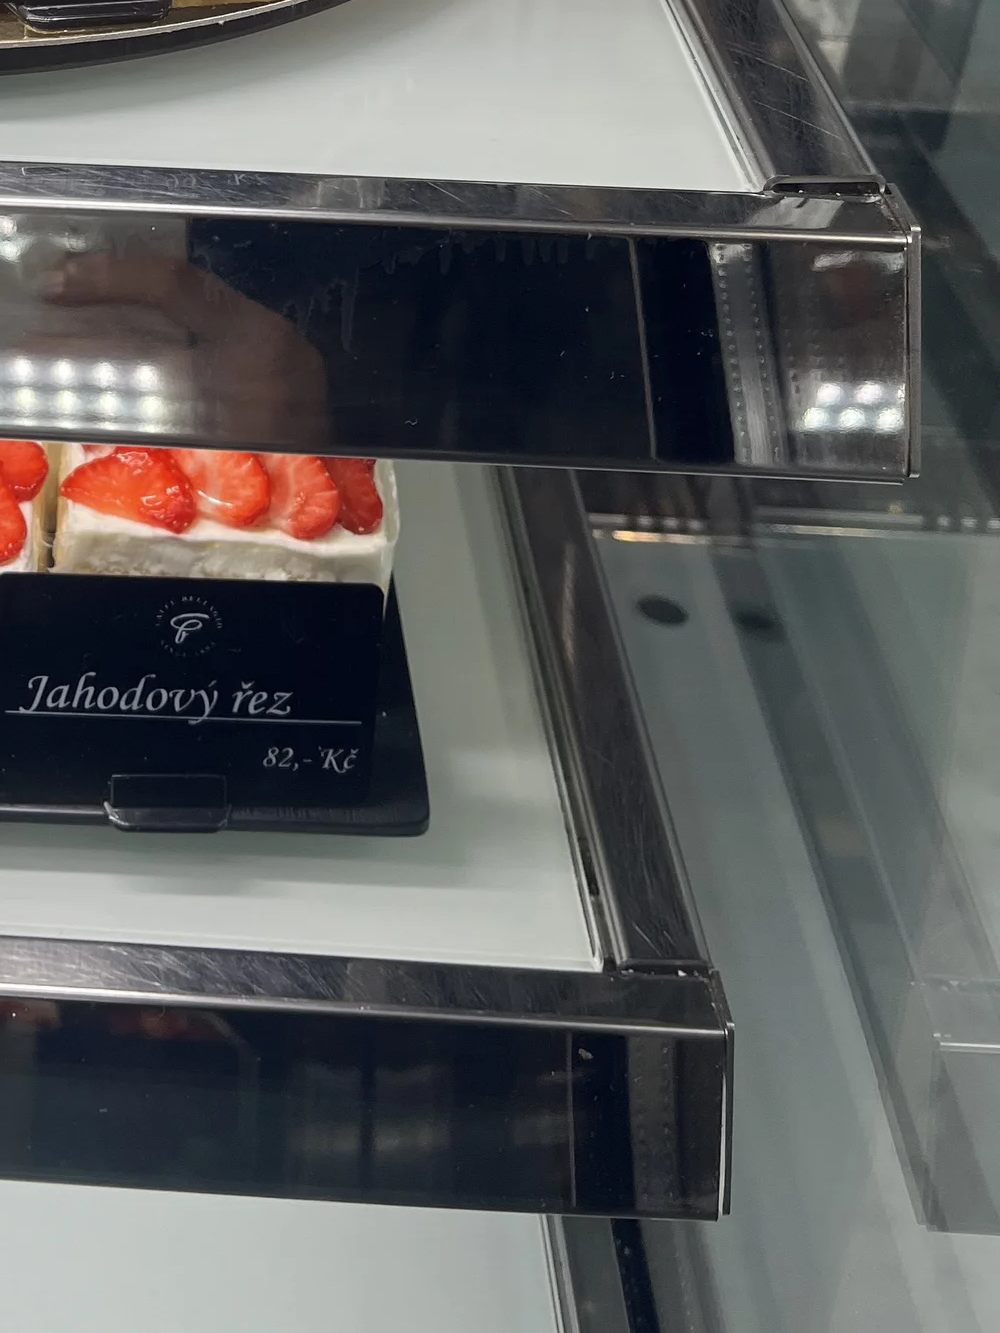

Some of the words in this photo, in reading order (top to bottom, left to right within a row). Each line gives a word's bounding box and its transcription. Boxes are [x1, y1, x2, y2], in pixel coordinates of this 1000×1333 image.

[18, 671, 219, 725] Jahodový
[230, 680, 294, 716] řez
[262, 747, 313, 771] 82,-
[320, 748, 360, 774] Kč
